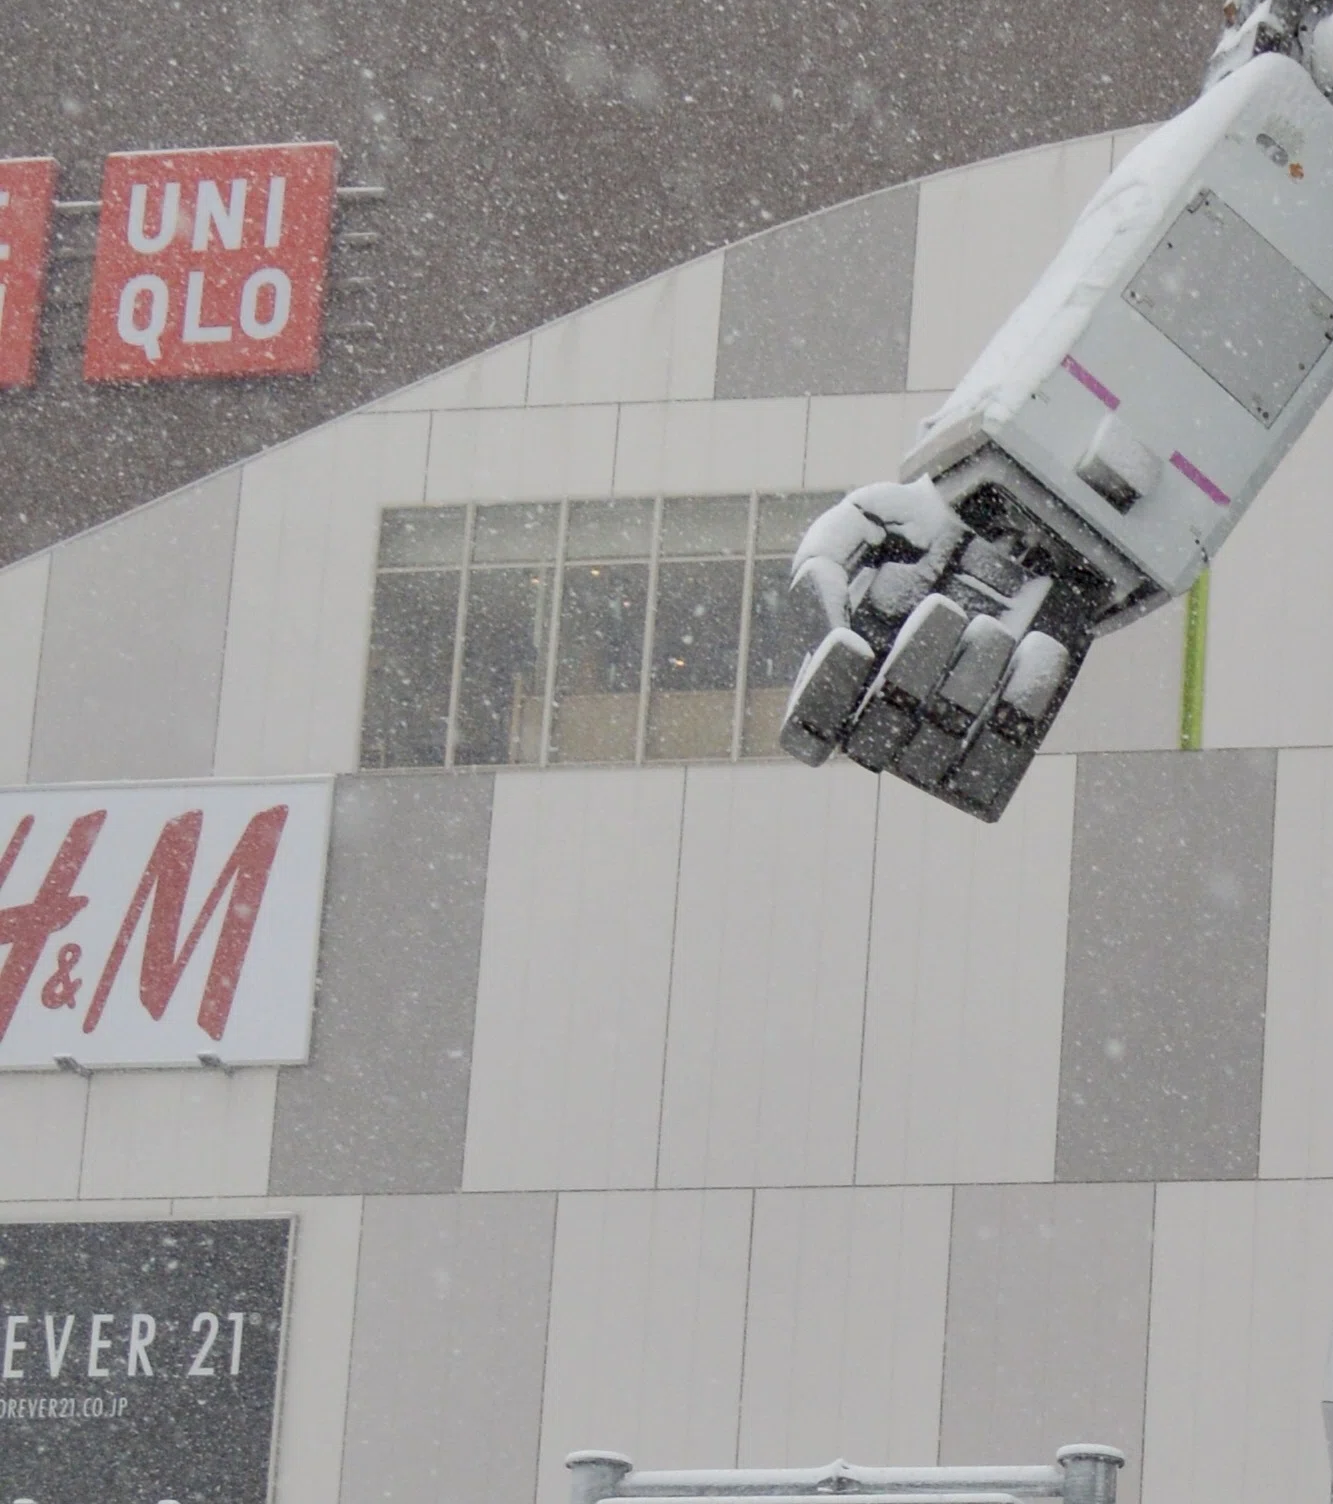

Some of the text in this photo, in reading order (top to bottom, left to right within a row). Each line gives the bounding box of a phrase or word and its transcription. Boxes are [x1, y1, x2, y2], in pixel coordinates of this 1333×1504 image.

[127, 176, 286, 254] UNI
[117, 268, 292, 360] QLO
[0, 804, 290, 1042] H&M
